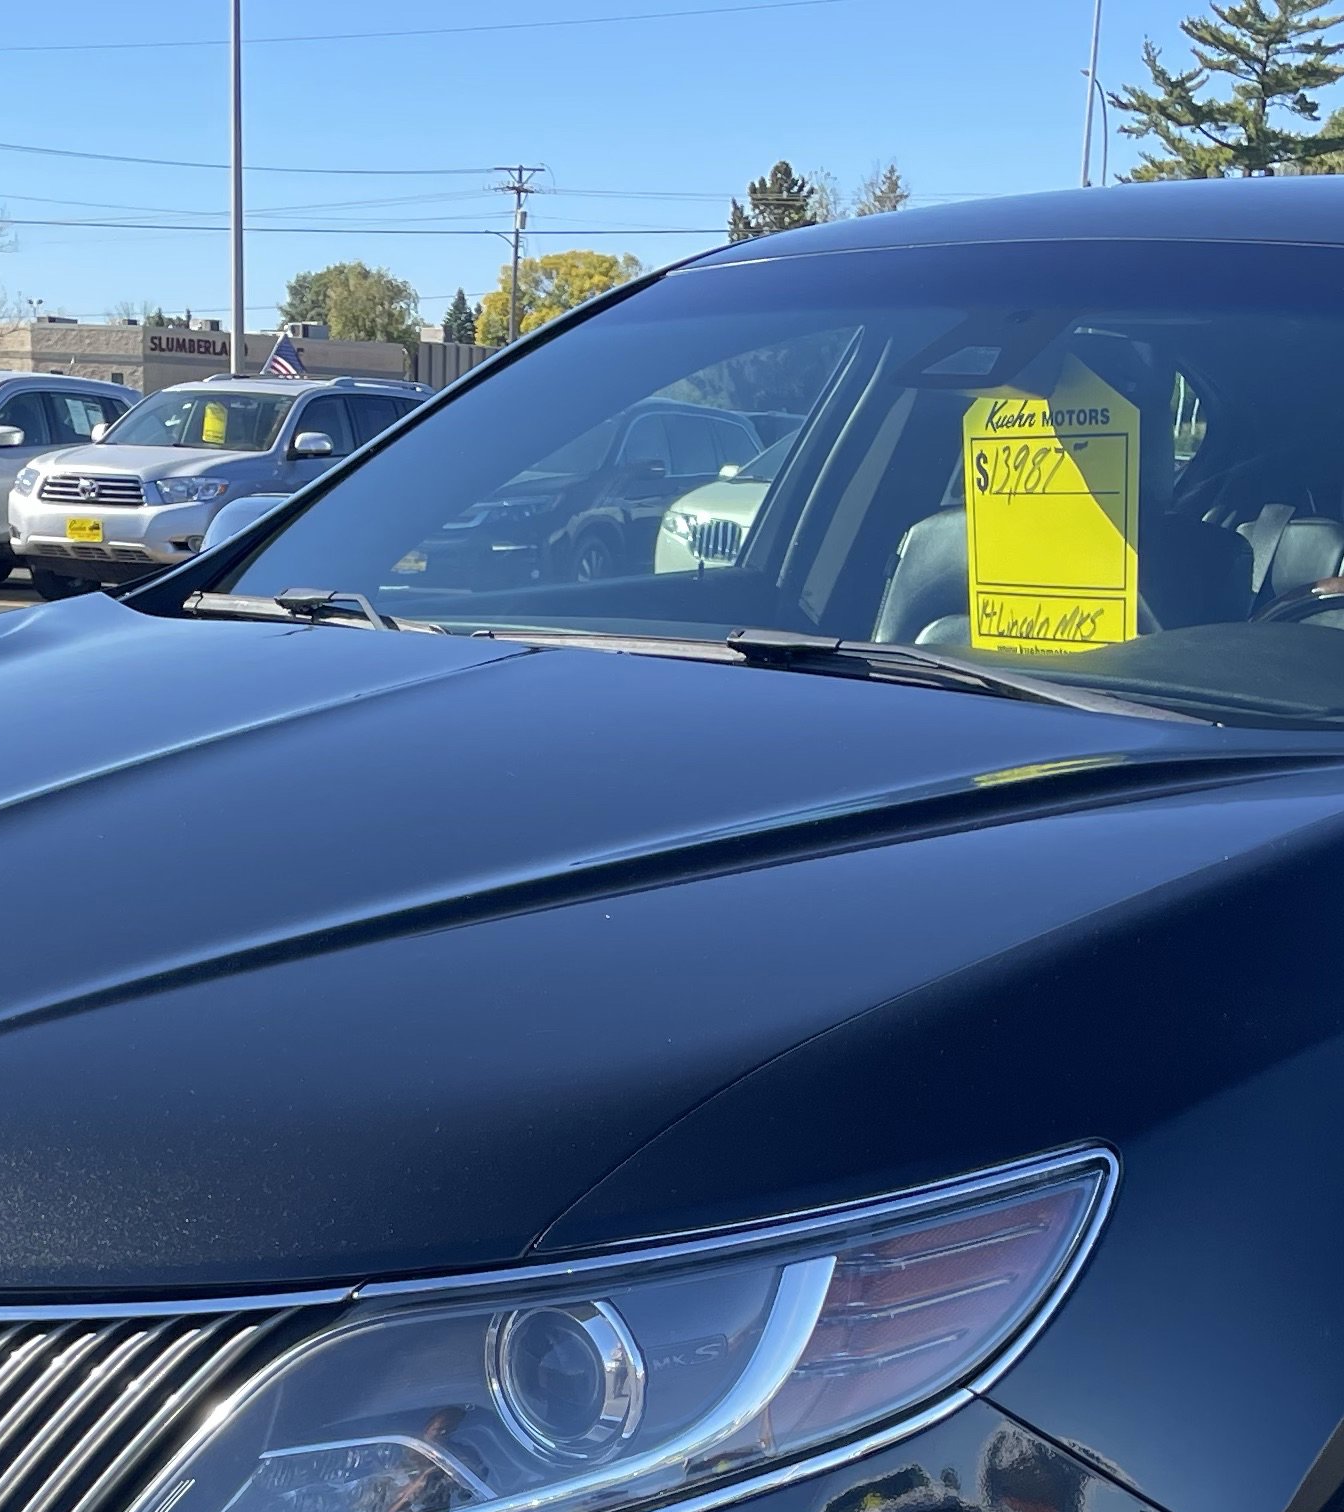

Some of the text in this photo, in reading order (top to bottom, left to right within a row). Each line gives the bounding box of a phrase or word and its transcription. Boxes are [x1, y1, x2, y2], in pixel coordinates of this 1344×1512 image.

[150, 336, 248, 356] SLUMBERLA
[985, 400, 1111, 432] Kuehn MOTORS
[1053, 605, 1105, 641] MKS
[653, 1343, 721, 1370] MKS
